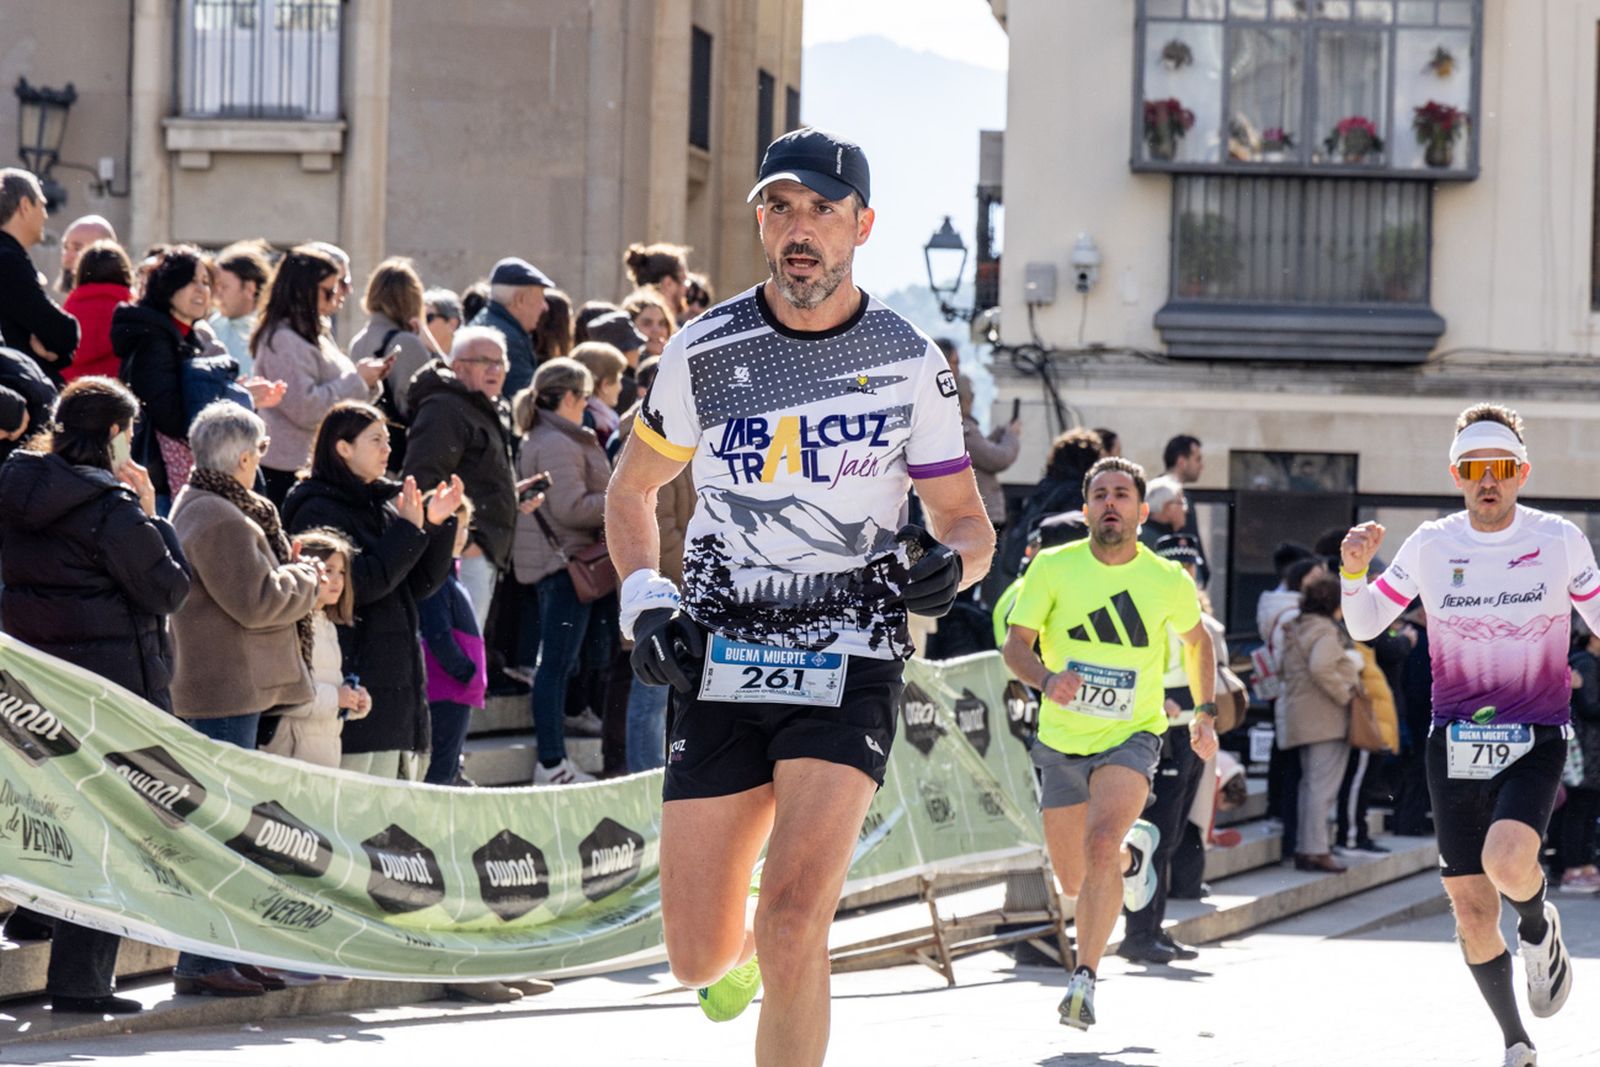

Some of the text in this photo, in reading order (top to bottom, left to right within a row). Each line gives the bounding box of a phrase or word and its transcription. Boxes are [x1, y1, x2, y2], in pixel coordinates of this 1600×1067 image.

[827, 449, 879, 490] Jaén
[1440, 594, 1481, 609] SIERRA
[1493, 591, 1543, 607] SEGURA
[725, 647, 806, 665] BUENA MUERTE
[741, 666, 805, 690] 261
[1074, 684, 1117, 707] 170
[1472, 744, 1510, 765] 719
[255, 820, 321, 863] ownat
[377, 852, 433, 885] ownat
[485, 853, 538, 887] ownat
[591, 837, 636, 876] ownat
